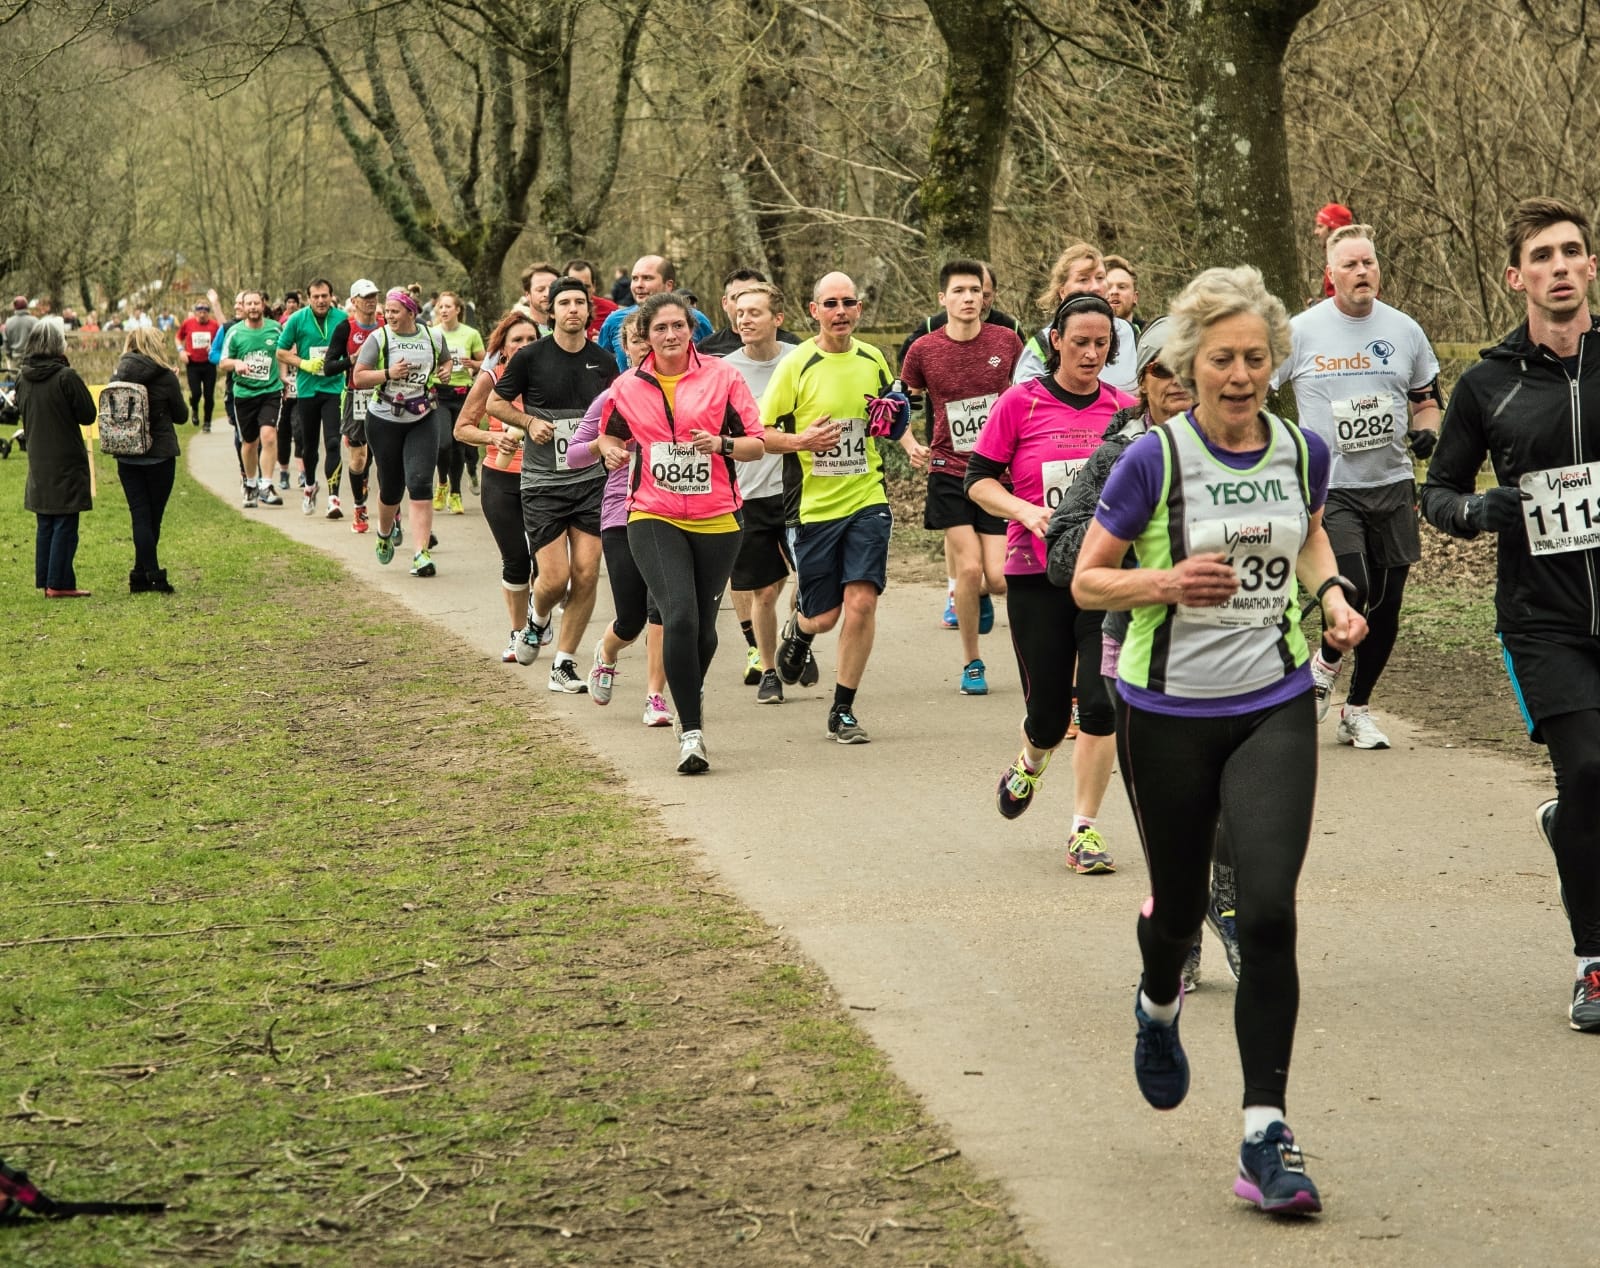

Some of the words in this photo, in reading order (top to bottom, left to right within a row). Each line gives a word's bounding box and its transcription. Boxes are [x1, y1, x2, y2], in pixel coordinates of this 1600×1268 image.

[397, 342, 426, 350] YEOVIL
[1315, 352, 1371, 372] Sands
[1338, 413, 1394, 440] 0282
[652, 463, 709, 482] 0845
[1545, 467, 1592, 499] Yeovil
[1205, 479, 1289, 506] YEOVIL
[1223, 521, 1272, 554] Yeovil
[1555, 536, 1572, 548] HALF
[1573, 532, 1600, 546] MARATH
[1225, 556, 1291, 592] 39
[1232, 596, 1270, 610] MARATHON
